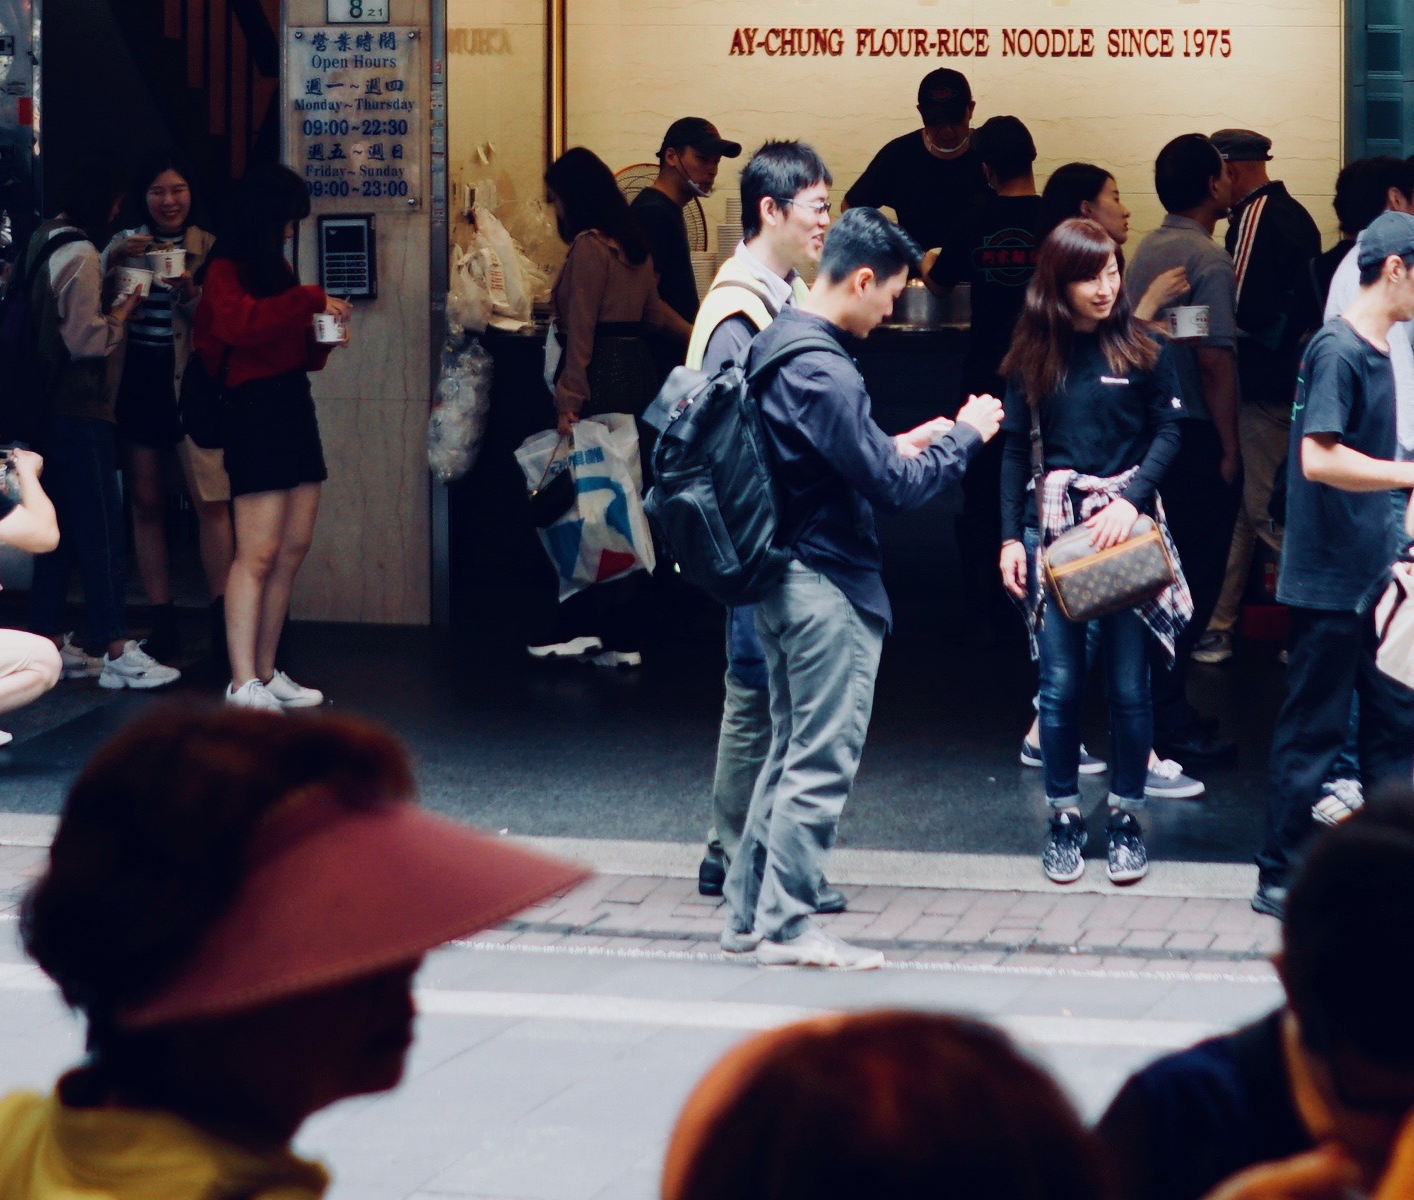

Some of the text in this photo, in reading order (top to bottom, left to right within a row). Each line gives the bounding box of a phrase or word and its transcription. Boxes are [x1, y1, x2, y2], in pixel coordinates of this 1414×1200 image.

[311, 31, 397, 52] 營業時間
[727, 28, 1232, 58] AY-CHUNG FLOUR-RICE NOODLE SINCE 1975
[311, 54, 397, 72] Open Hours
